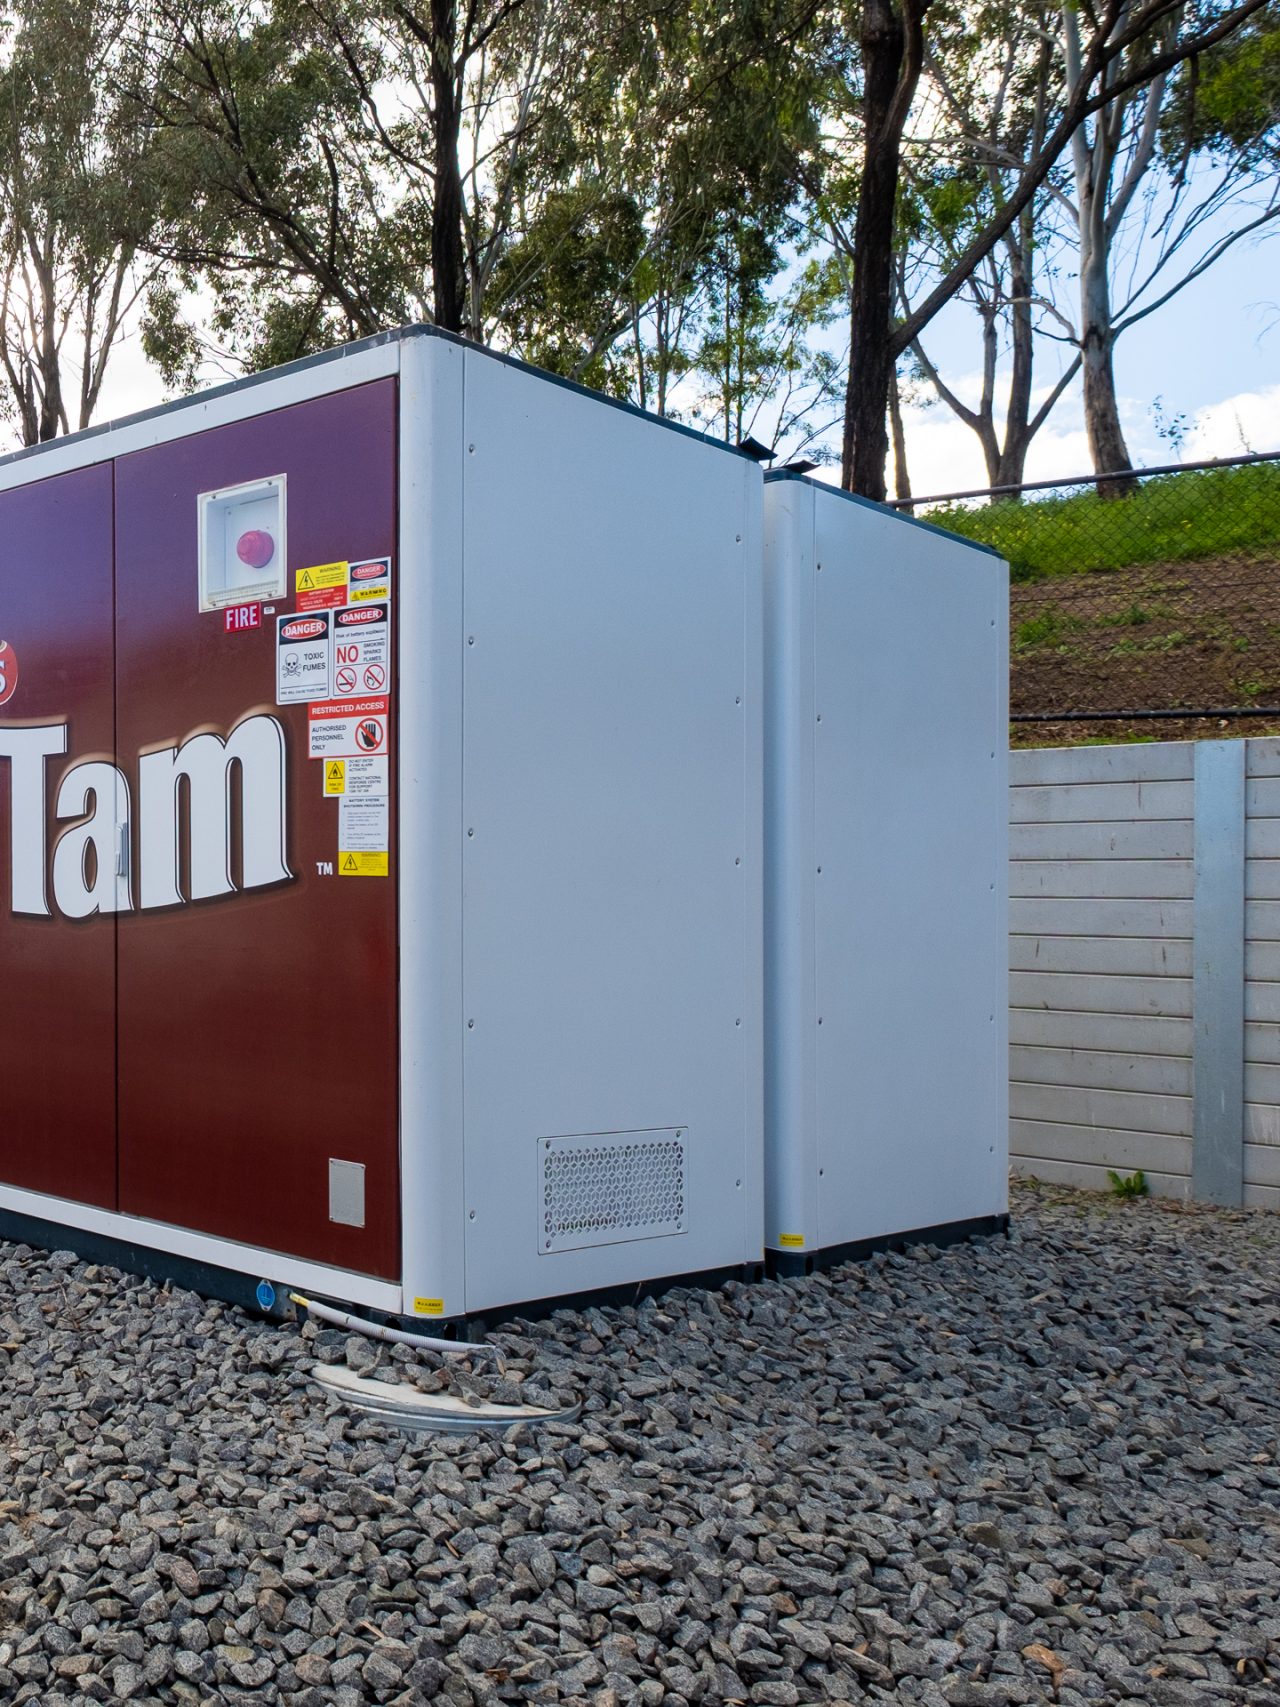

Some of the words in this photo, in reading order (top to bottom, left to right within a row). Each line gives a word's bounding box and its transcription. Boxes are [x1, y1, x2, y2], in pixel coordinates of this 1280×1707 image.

[357, 565, 381, 575] DANGER
[226, 605, 258, 630] FIRE
[342, 610, 379, 621] DANGER
[285, 622, 323, 636] DANGER
[304, 652, 324, 661] TOXIC
[337, 645, 359, 664] NO
[302, 662, 326, 672] FUMES
[312, 704, 354, 715] RESTRICTED
[355, 701, 385, 711] ACCESS
[312, 725, 347, 733] AUTHORISED
[312, 734, 344, 742] PERSONNEL
[316, 862, 333, 875] TM
